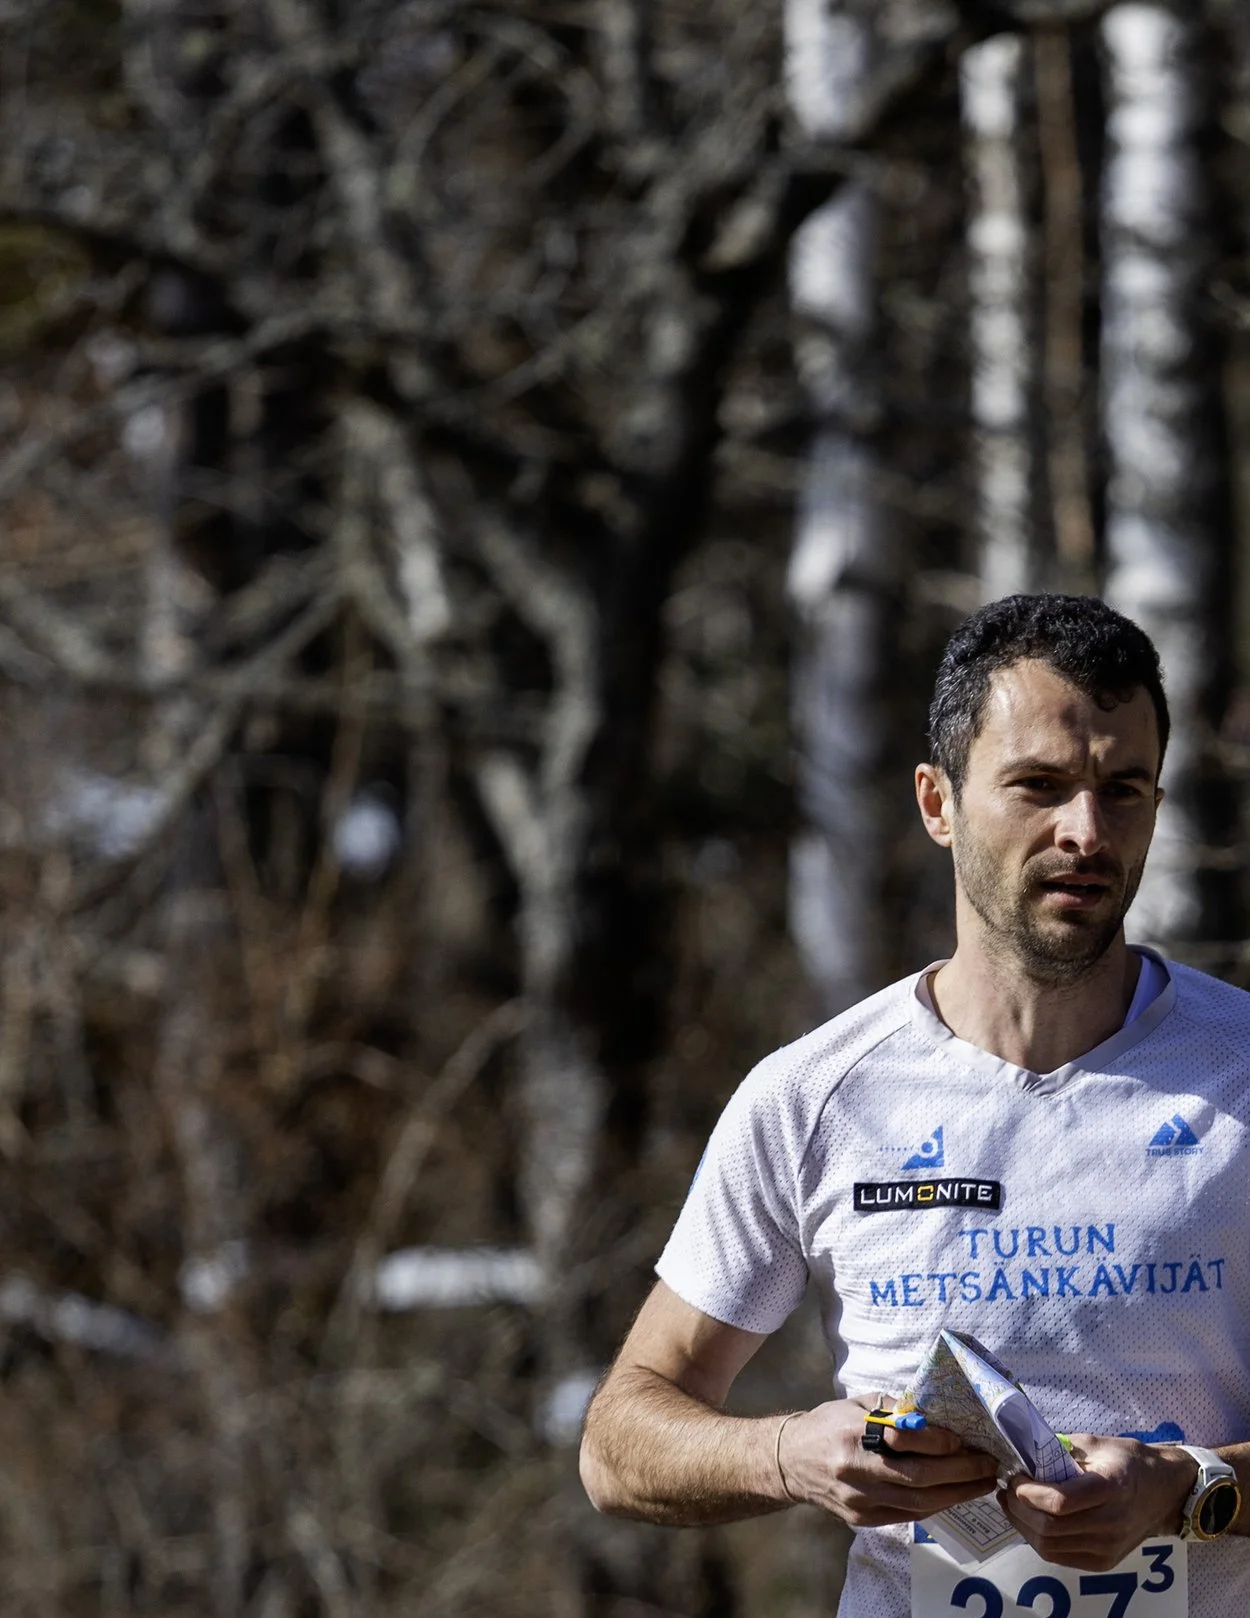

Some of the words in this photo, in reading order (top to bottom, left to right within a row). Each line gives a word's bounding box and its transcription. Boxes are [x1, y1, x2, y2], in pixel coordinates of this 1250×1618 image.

[1144, 1147, 1171, 1157] TRUE
[1174, 1146, 1204, 1157] STORY
[860, 1182, 993, 1204] LUMONITE
[958, 1223, 1115, 1259] TURUN
[869, 1254, 1225, 1307] METSÄNKÄVIJÄT
[1142, 1544, 1174, 1593] 3
